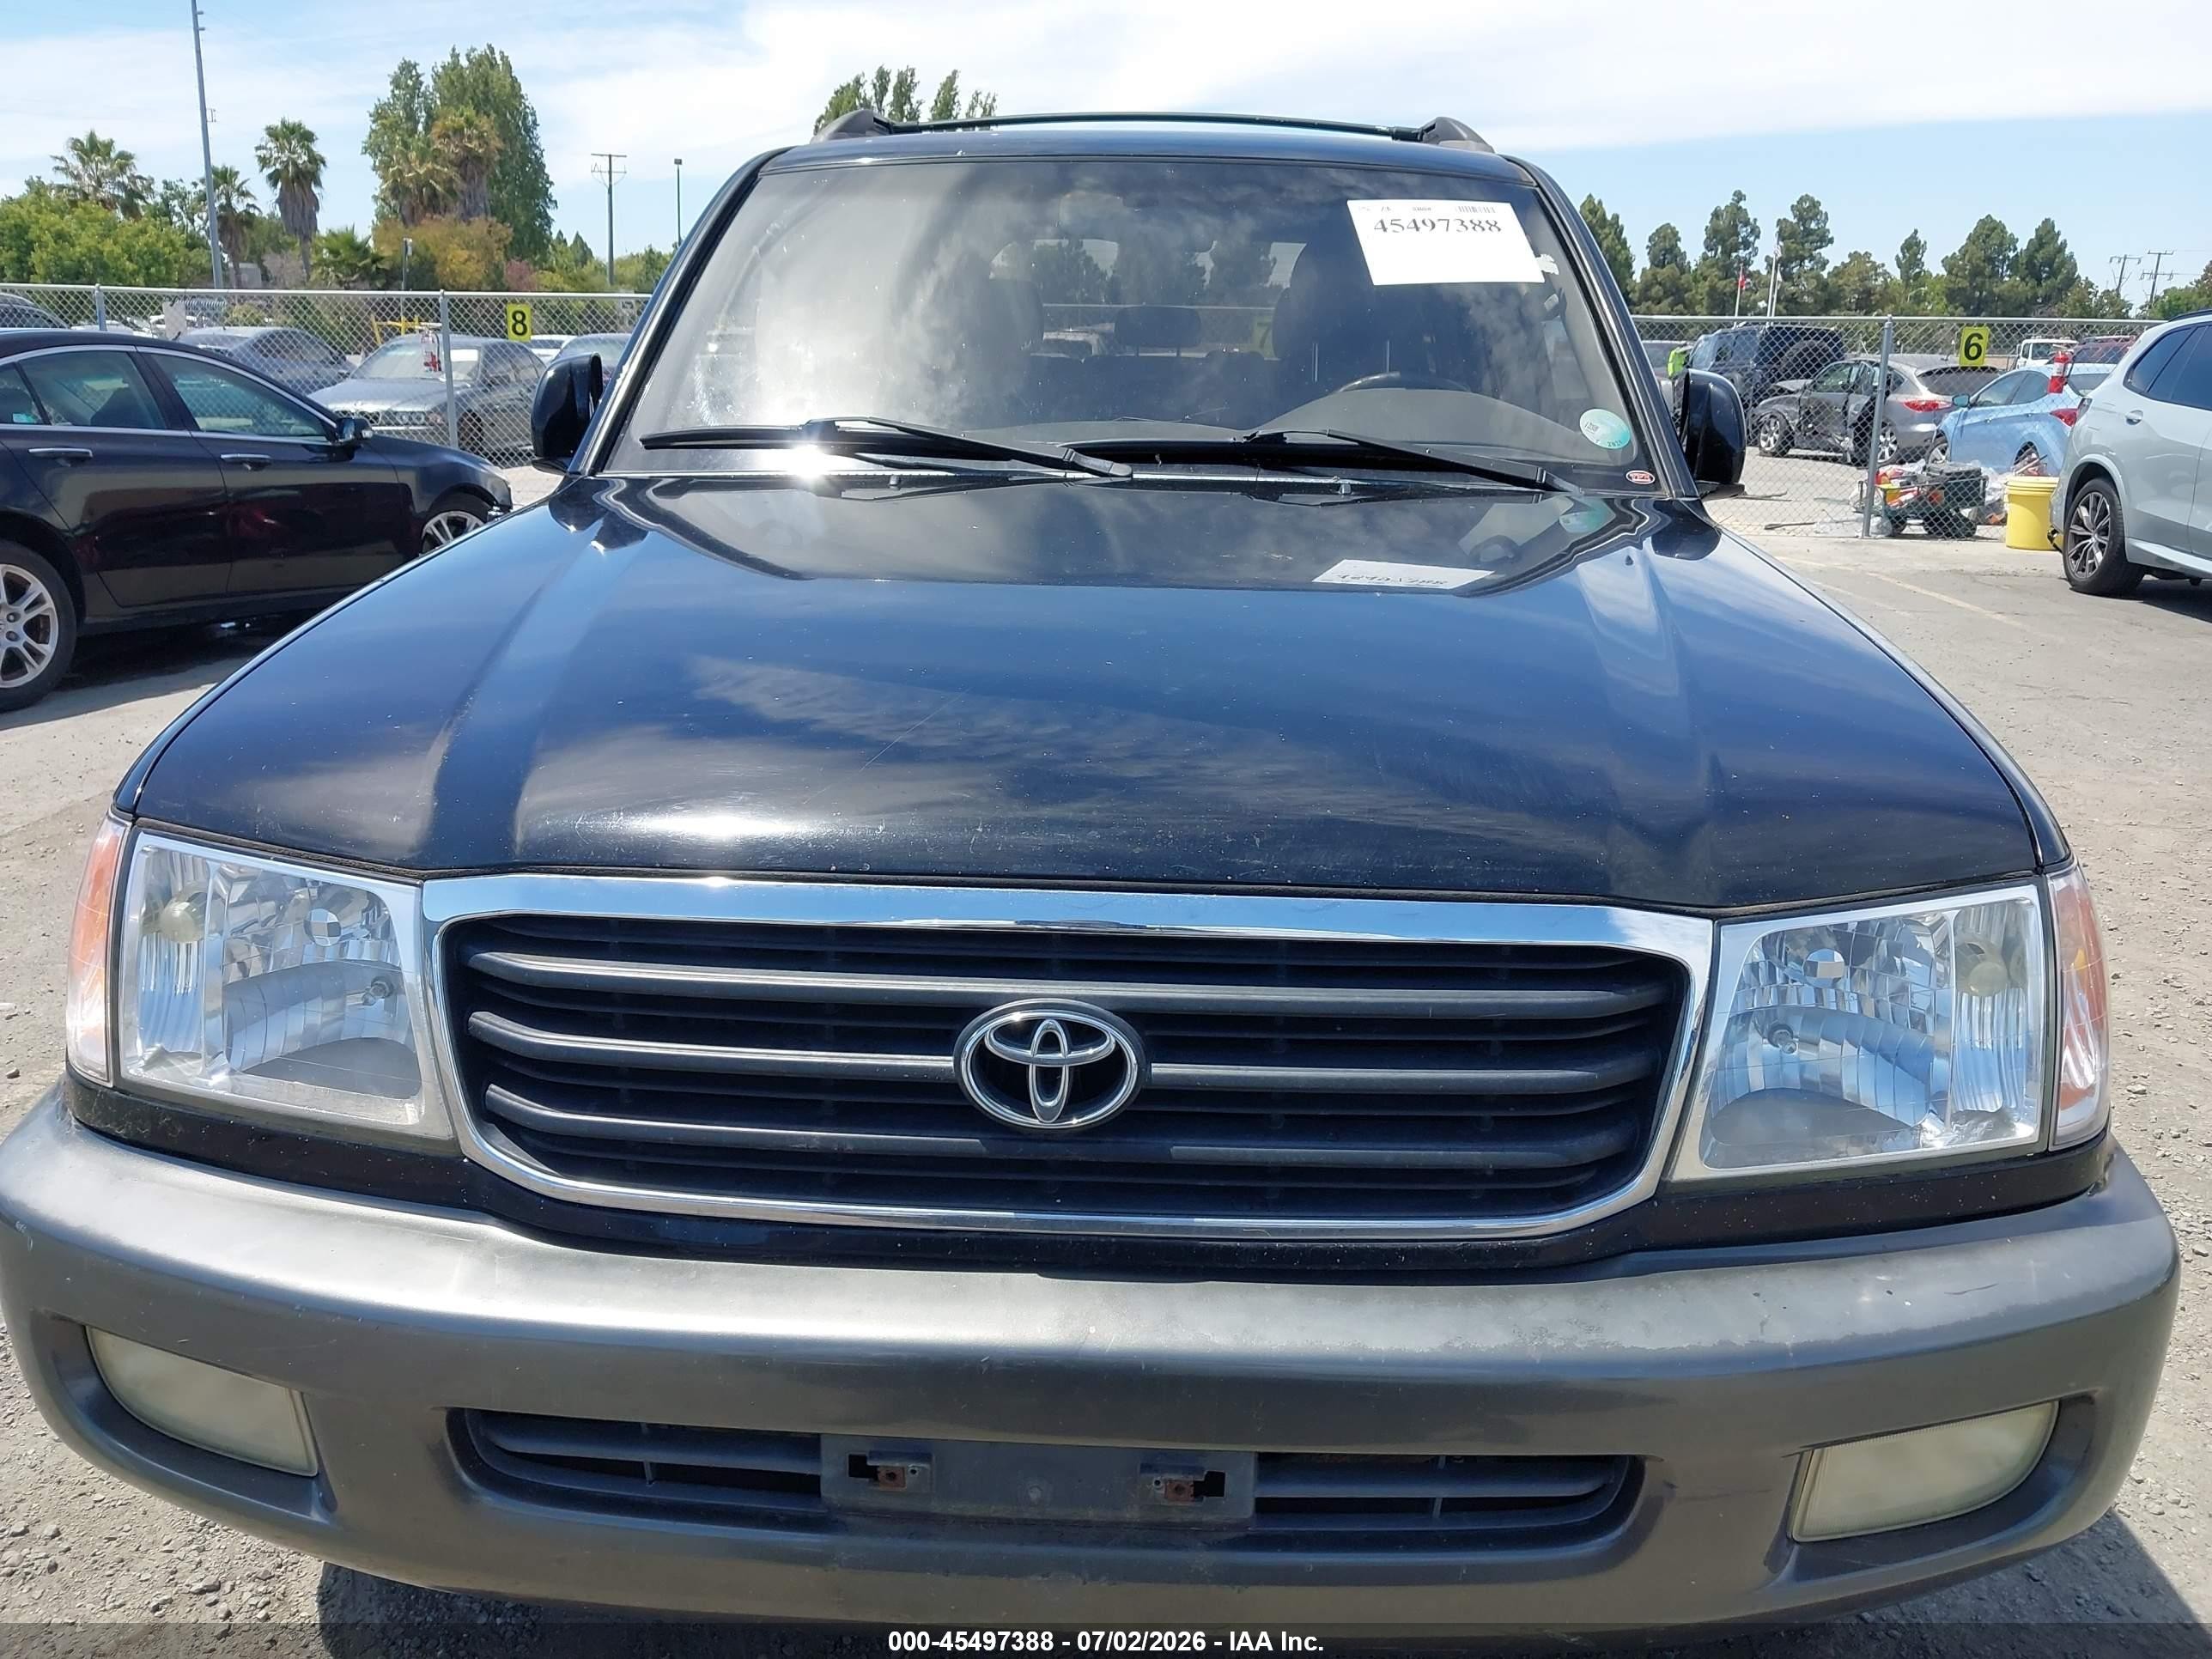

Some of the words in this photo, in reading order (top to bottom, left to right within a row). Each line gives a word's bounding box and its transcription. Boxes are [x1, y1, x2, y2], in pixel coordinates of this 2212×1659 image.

[1374, 218, 1502, 233] 45497388
[512, 310, 528, 336] 8
[1965, 332, 1984, 361] 6
